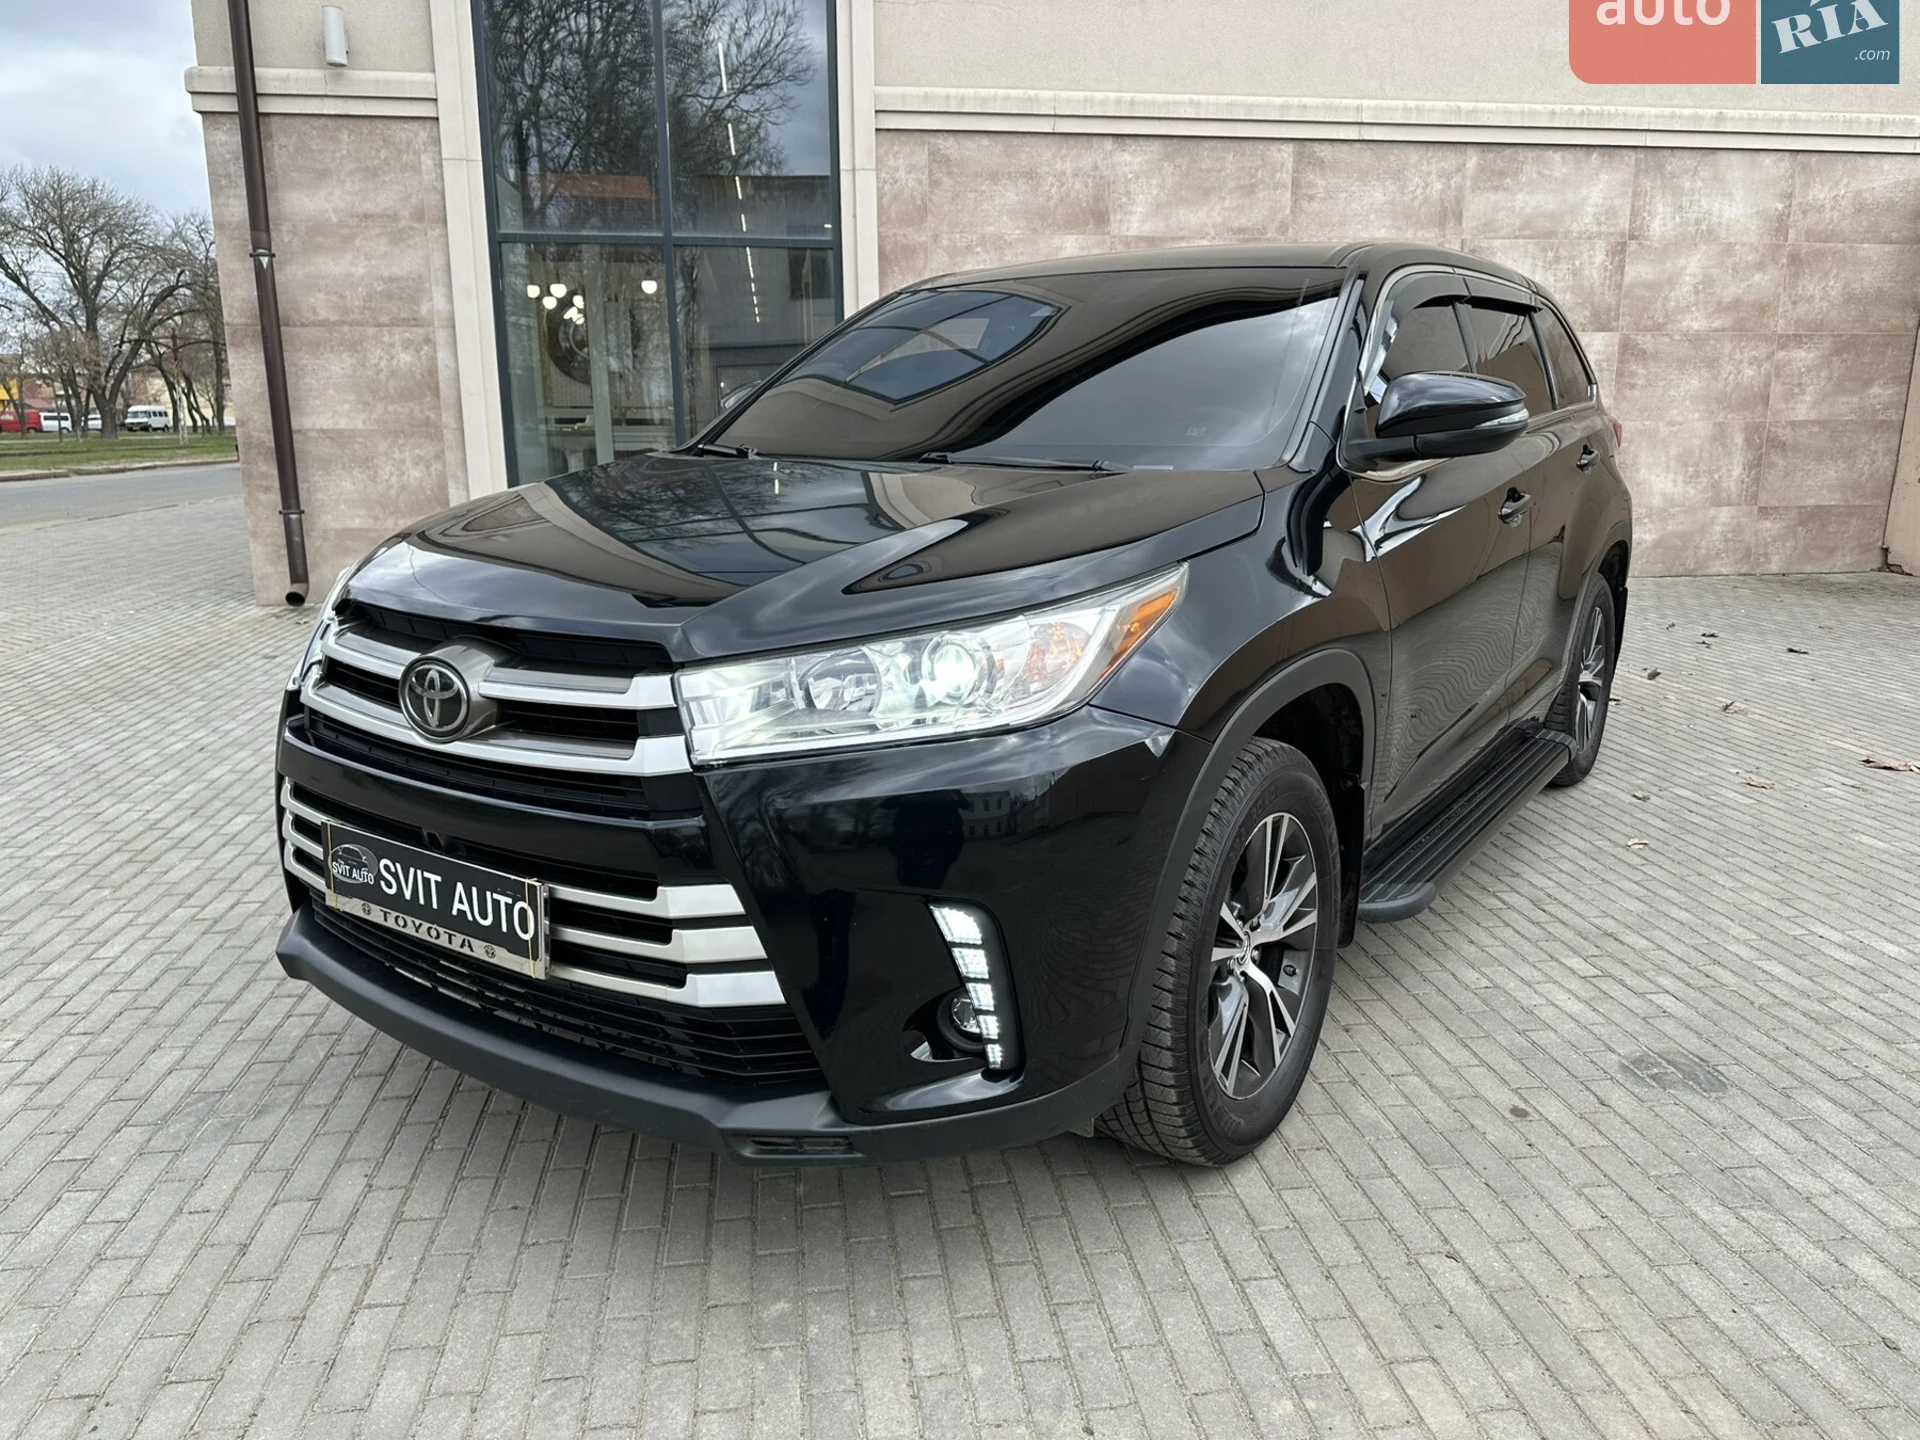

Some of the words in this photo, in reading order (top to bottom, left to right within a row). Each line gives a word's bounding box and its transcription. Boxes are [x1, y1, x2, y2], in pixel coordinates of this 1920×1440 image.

[332, 861, 350, 877] SVIT
[352, 867, 375, 885] AUTO
[379, 858, 442, 910] SVIT
[451, 881, 535, 941] AUTO
[379, 908, 475, 954] TOYOTA
